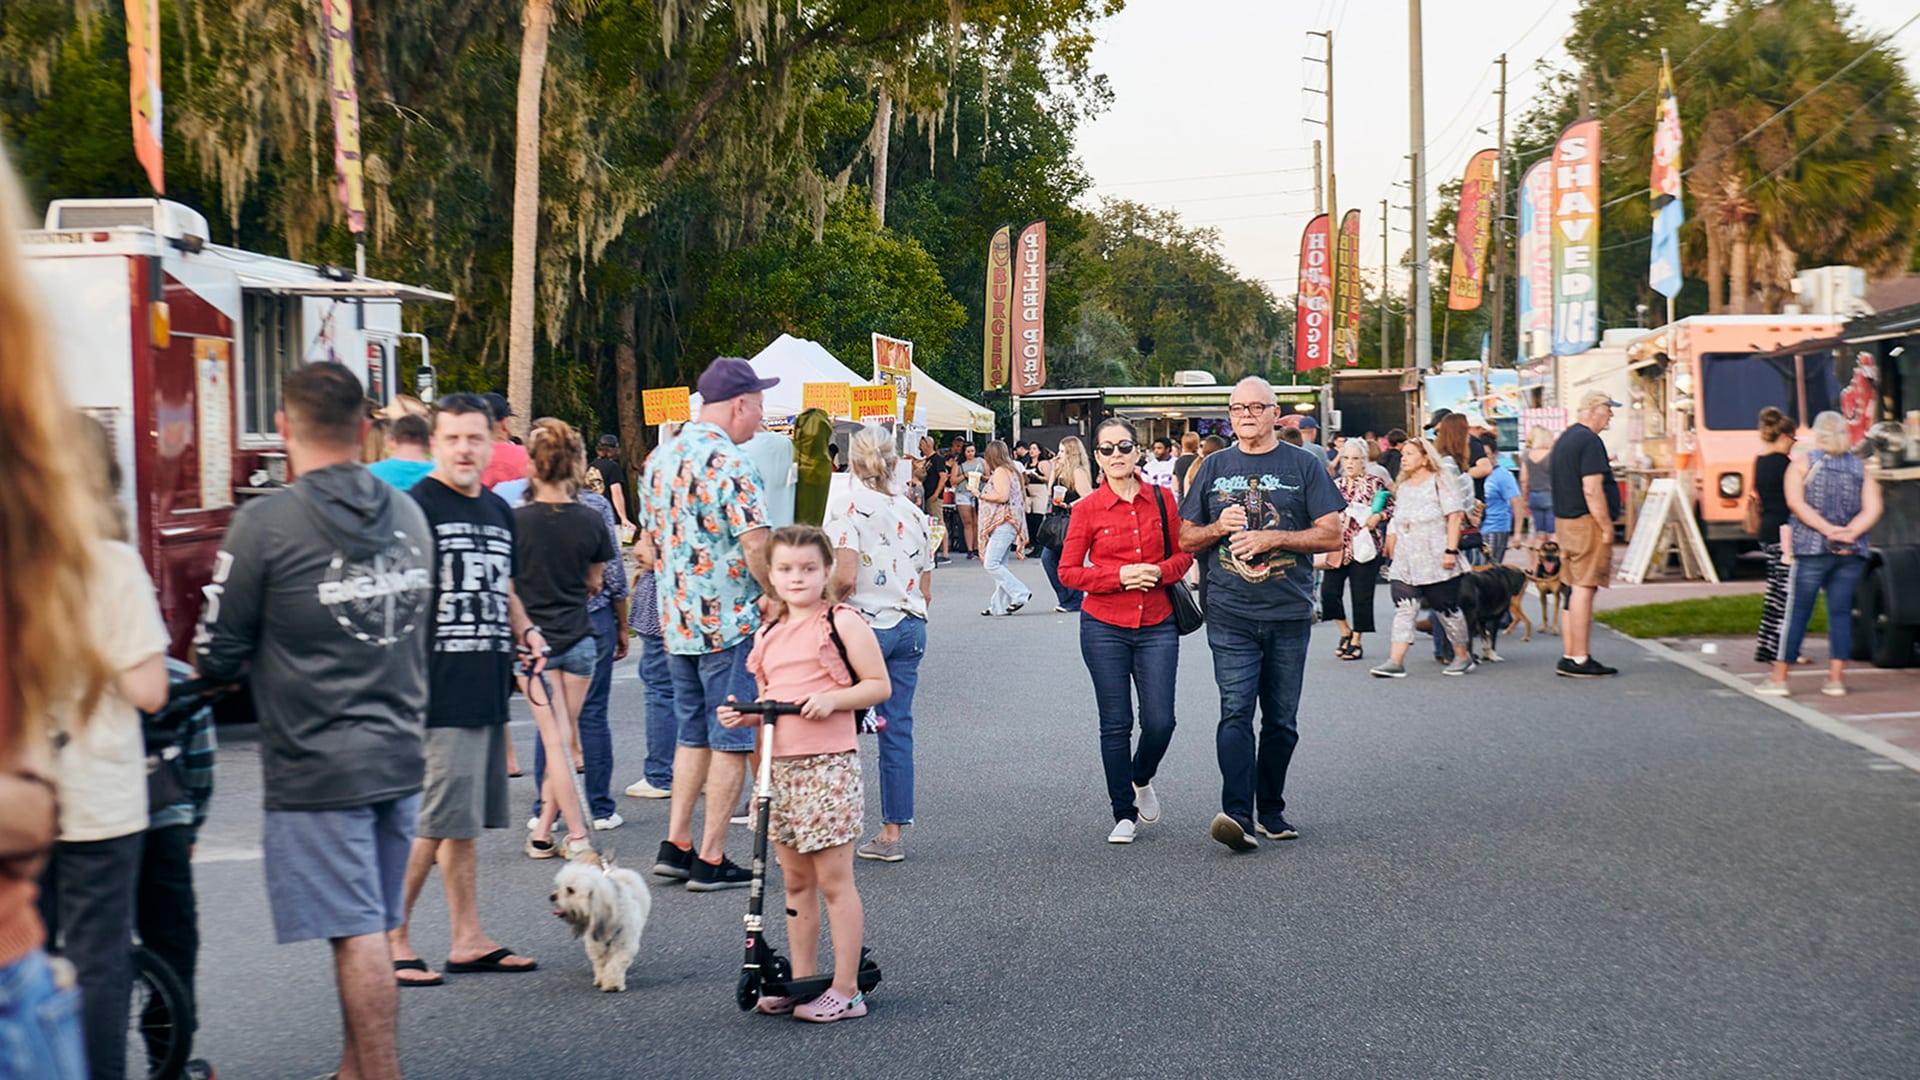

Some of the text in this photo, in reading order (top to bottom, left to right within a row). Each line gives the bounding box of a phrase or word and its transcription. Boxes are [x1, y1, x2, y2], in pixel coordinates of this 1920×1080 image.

[1556, 138, 1595, 296] SHAVED
[990, 267, 1007, 386] BURGERS
[1557, 301, 1597, 344] ICE
[853, 388, 893, 402] HOT BOILED
[858, 405, 889, 417] PEANUTS
